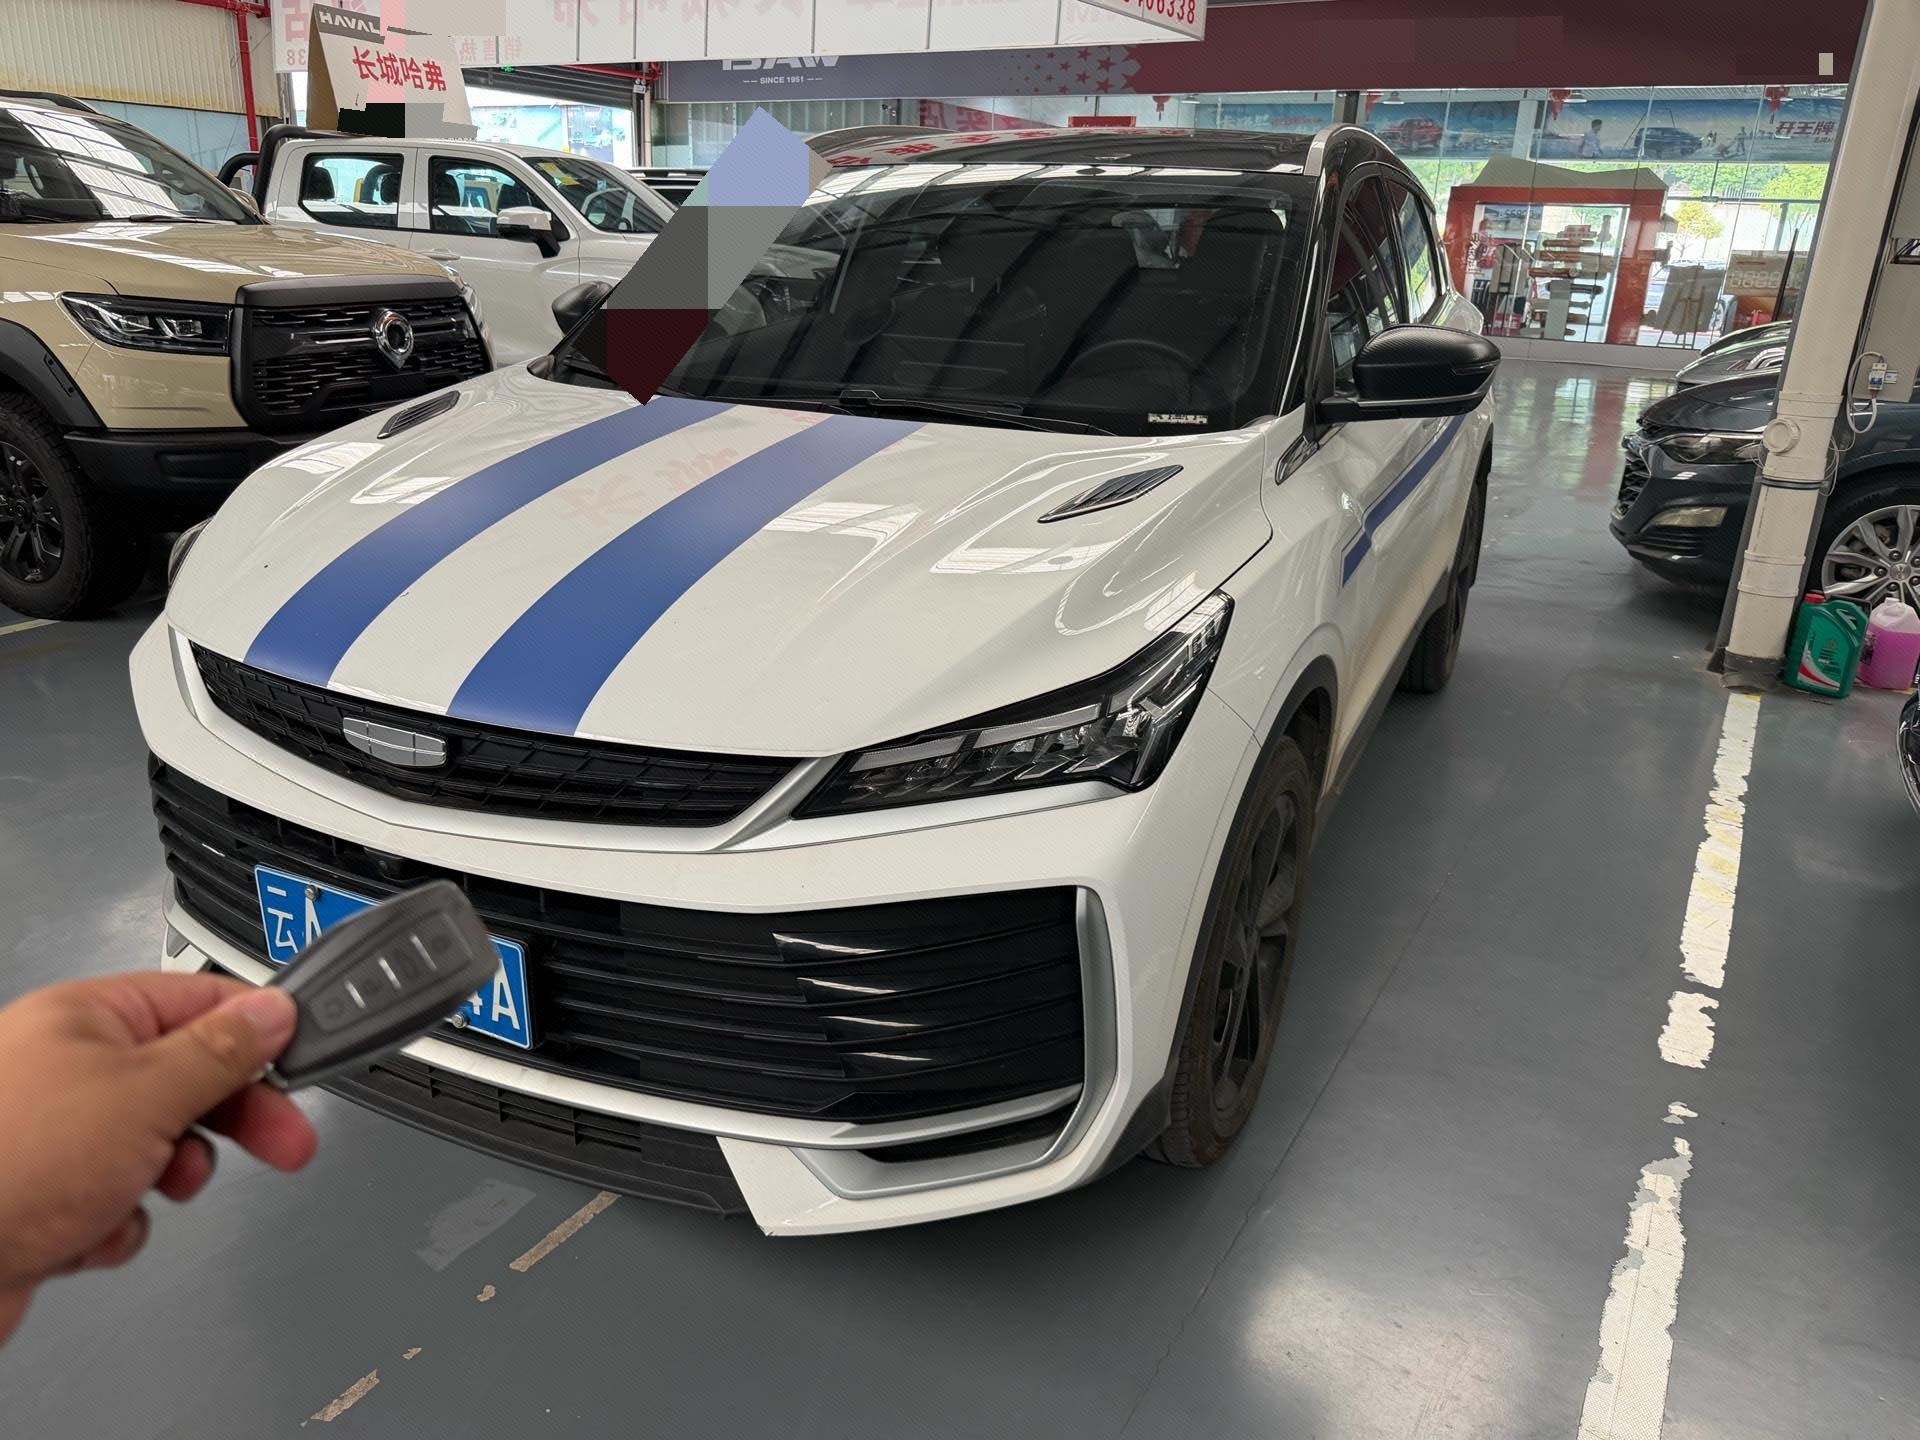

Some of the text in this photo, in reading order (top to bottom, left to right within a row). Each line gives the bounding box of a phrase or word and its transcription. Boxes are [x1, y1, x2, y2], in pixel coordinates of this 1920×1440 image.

[318, 11, 380, 34] HAVAL
[352, 46, 447, 92] 长城哈弗
[760, 76, 804, 85] SINCE 1951
